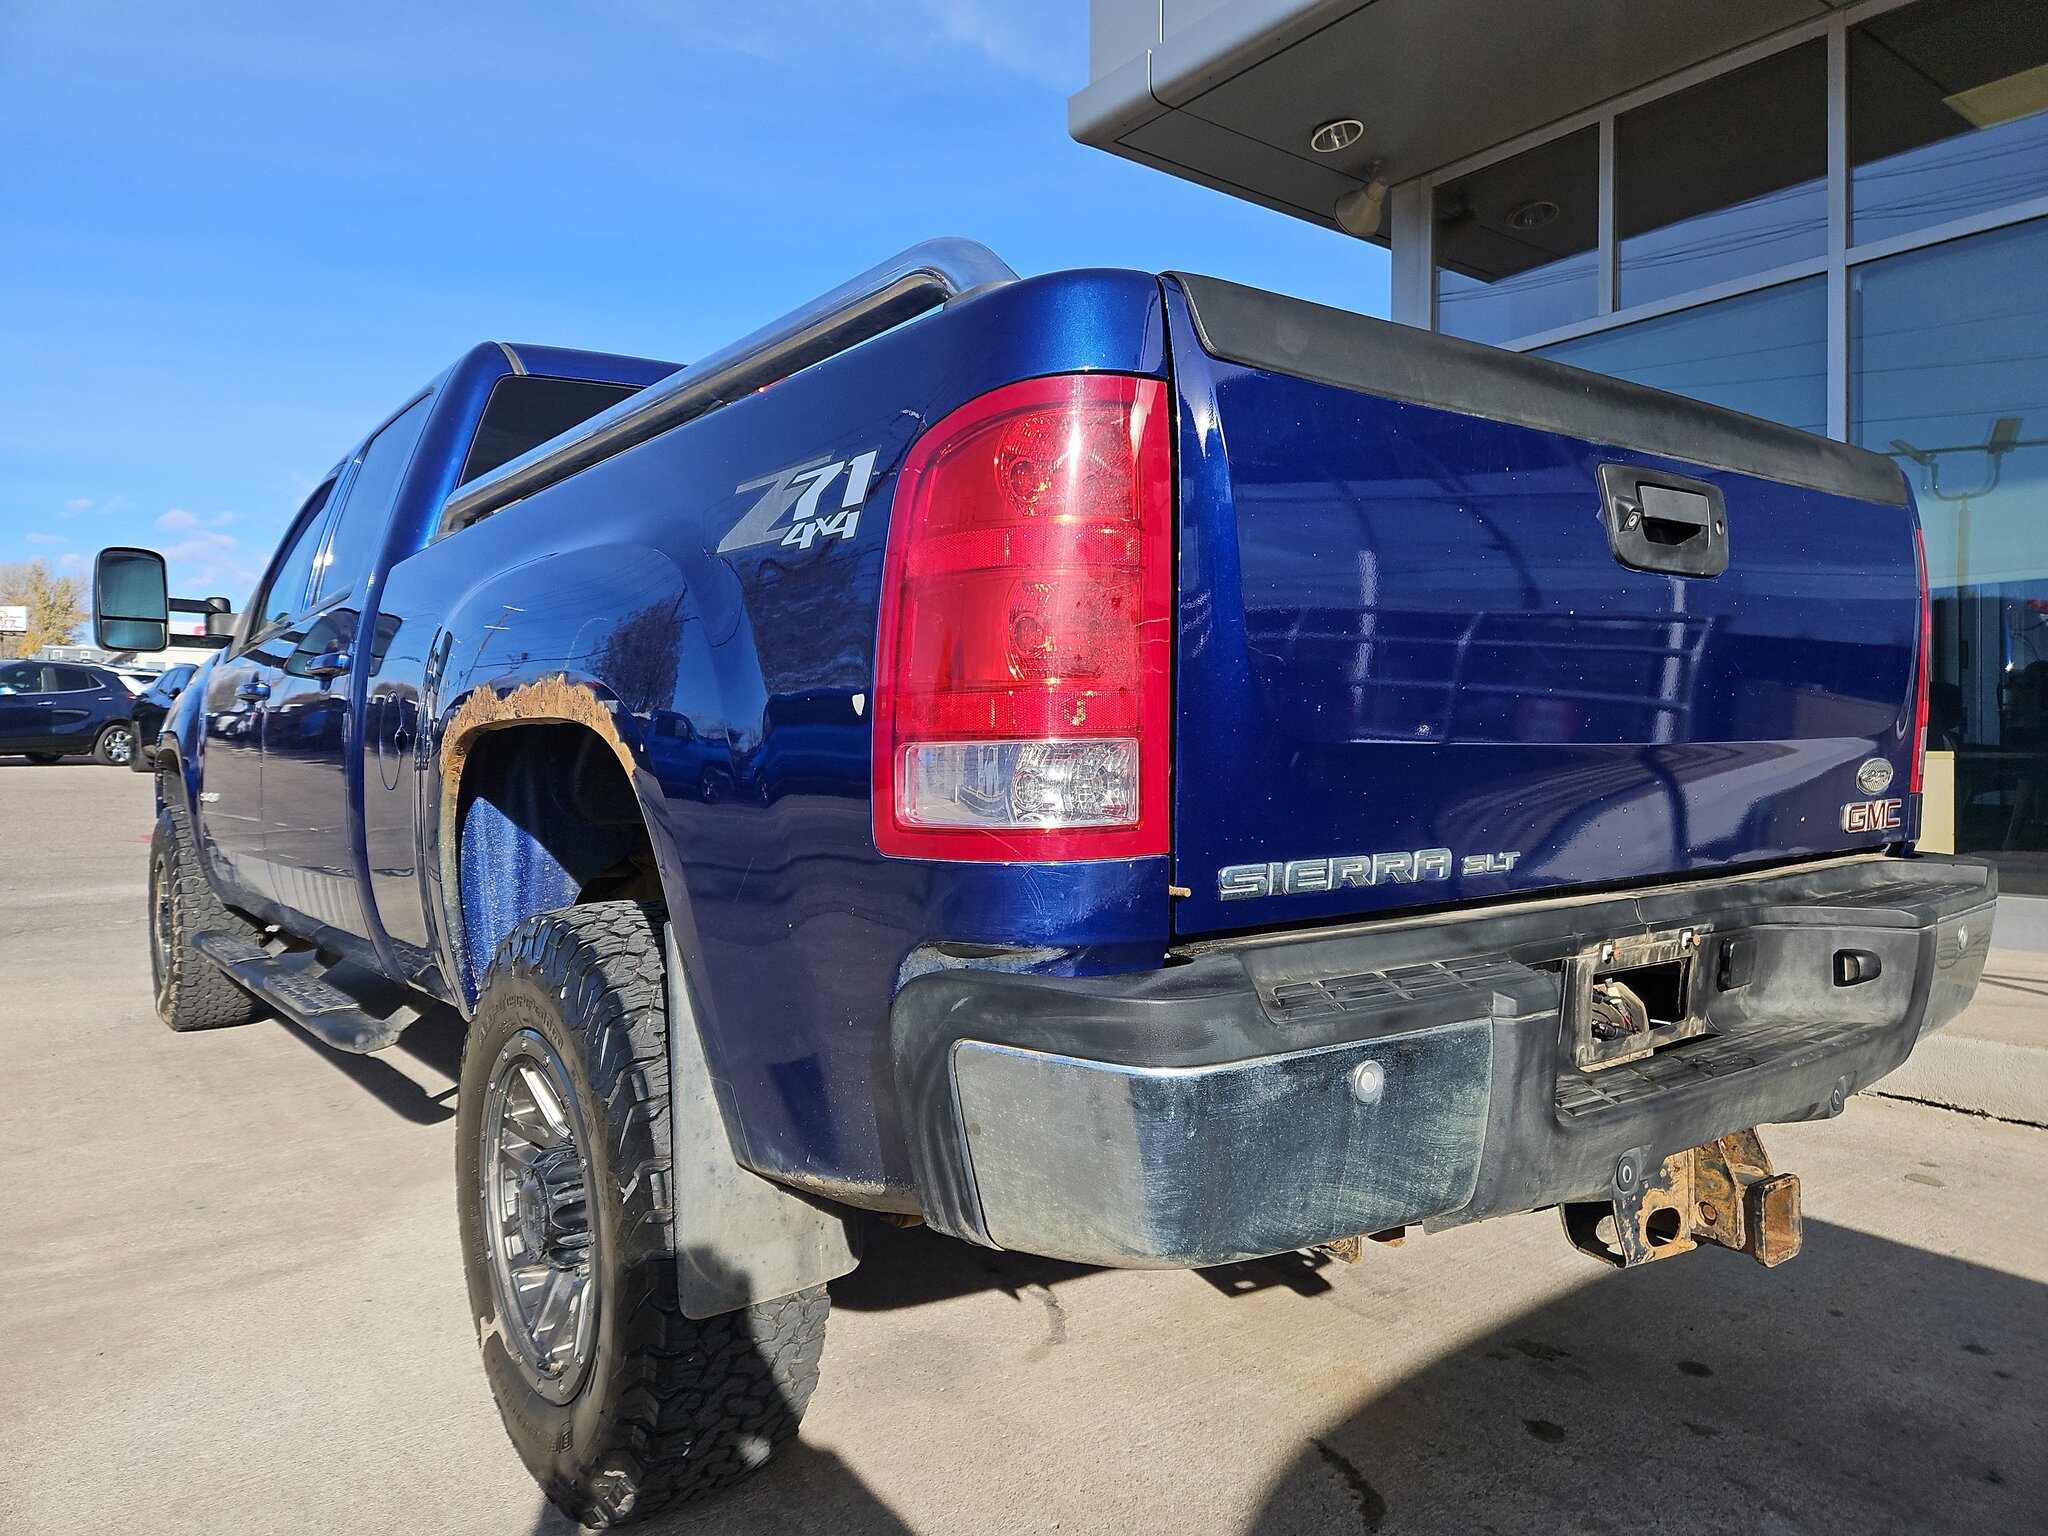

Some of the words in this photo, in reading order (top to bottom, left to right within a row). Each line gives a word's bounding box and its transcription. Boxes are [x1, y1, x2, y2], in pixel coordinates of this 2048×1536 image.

[717, 450, 878, 553] Z71
[1840, 798, 1902, 833] GMC
[1218, 848, 1453, 901] SIERRA
[1461, 851, 1521, 876] SLT
